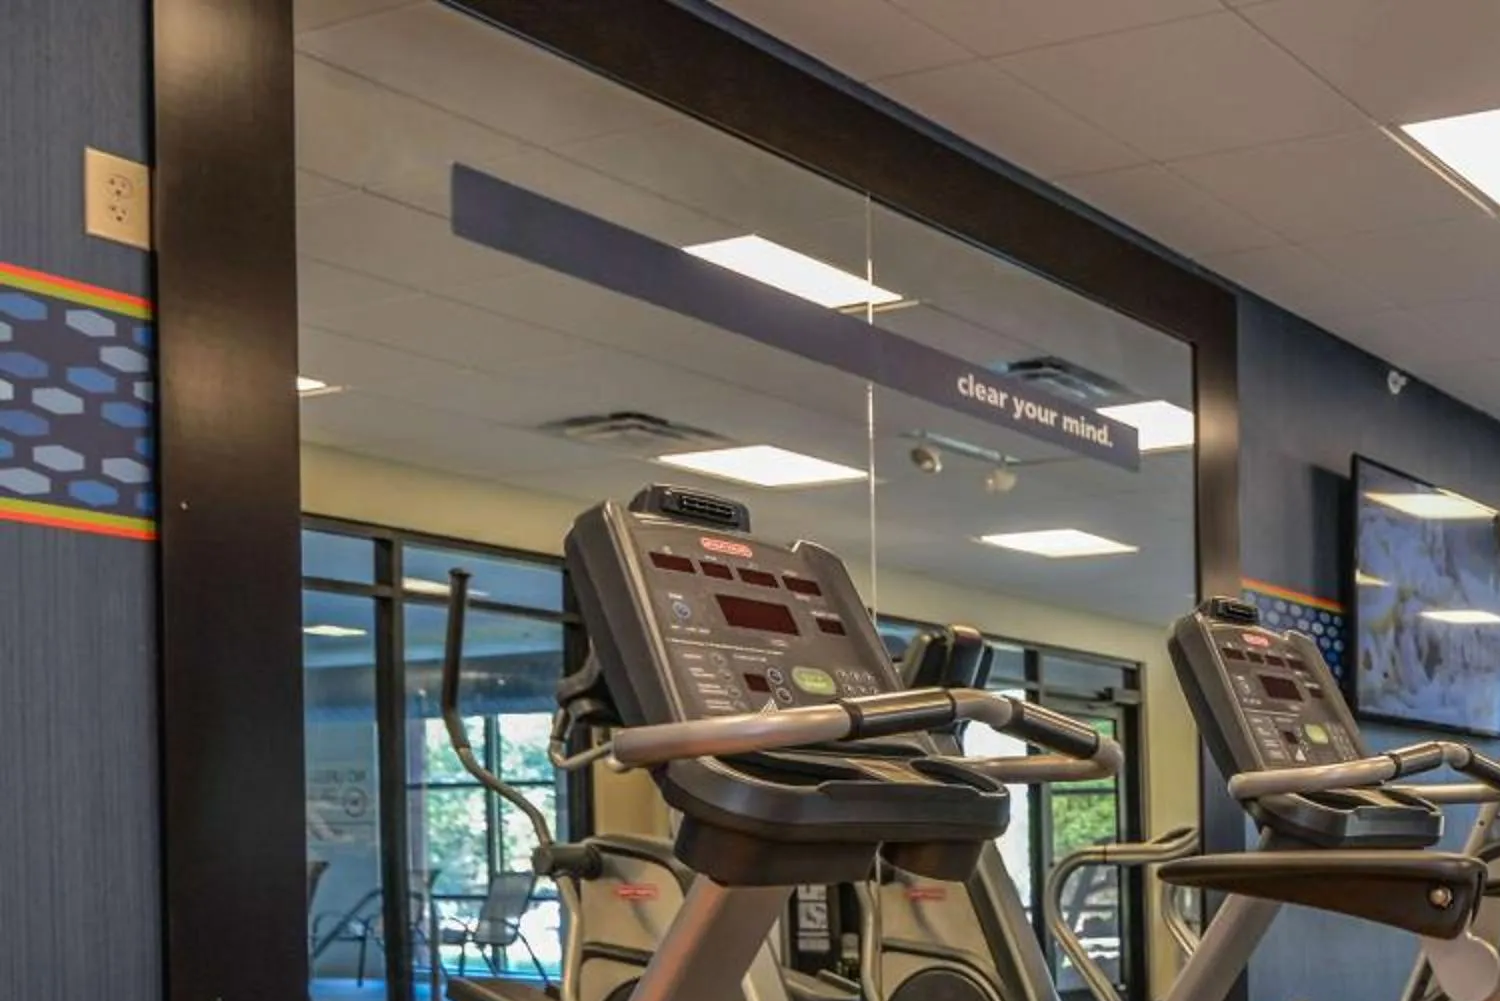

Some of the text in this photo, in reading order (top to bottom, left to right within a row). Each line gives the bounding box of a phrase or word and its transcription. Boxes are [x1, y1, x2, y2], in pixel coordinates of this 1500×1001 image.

[957, 374, 1114, 448] clear your mind.
